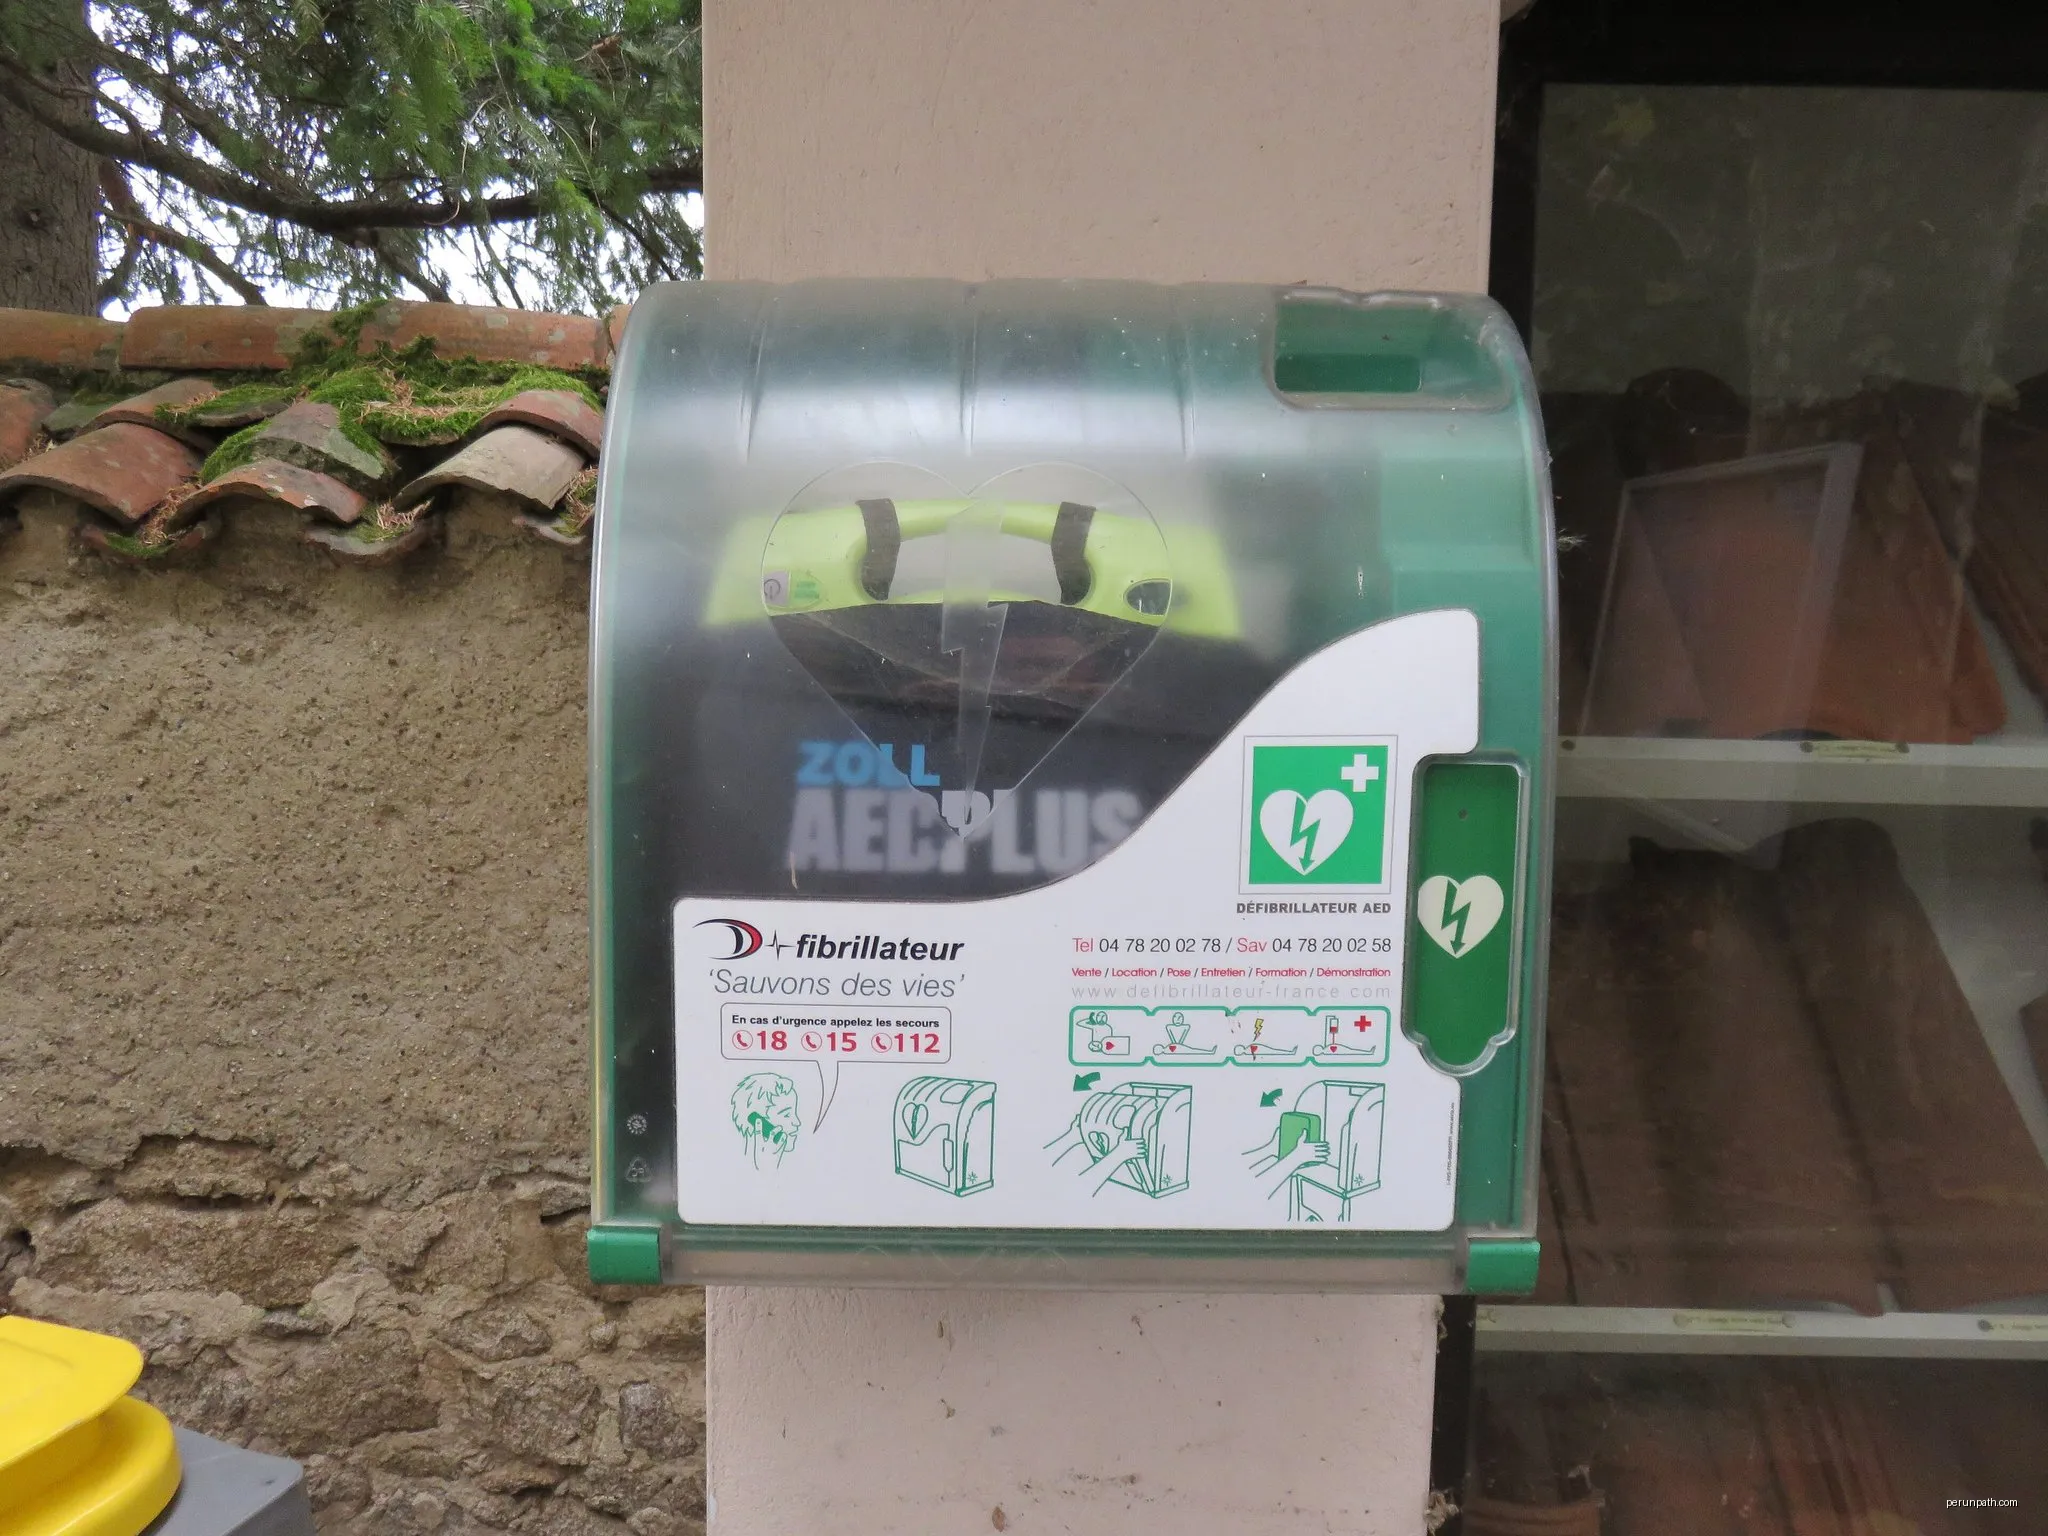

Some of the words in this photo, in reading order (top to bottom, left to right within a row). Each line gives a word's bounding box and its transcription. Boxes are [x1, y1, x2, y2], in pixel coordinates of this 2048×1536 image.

[796, 740, 941, 787] ZOLL
[1237, 900, 1357, 914] DÉFIBRILLATEUR
[1363, 902, 1393, 914] AED
[1072, 937, 1094, 953] Tel
[1099, 937, 1119, 953] 04
[1125, 937, 1144, 953] 78
[1150, 937, 1170, 953] 20
[1176, 937, 1196, 953] 02
[1202, 937, 1221, 953] 78
[1225, 937, 1233, 953] /
[1237, 937, 1267, 953] Sav
[1272, 937, 1292, 953] 04
[1298, 937, 1318, 953] 78
[1322, 937, 1342, 953] 20
[1347, 937, 1367, 953] 02
[1372, 937, 1392, 953] 58
[1072, 967, 1102, 979] Vente
[1112, 967, 1157, 979] Location
[1167, 967, 1191, 979] Pose
[1201, 967, 1245, 979] Entretien
[1255, 967, 1307, 979] Formation
[1317, 967, 1392, 979] Démonstration
[841, 972, 891, 996] des
[1072, 983, 1393, 999] wwwdefibrillateur-francecom
[731, 1014, 747, 1025] En
[750, 1017, 768, 1026] cas
[772, 1015, 827, 1028] d'urgence
[830, 1016, 872, 1029] appelez
[876, 1016, 892, 1027] les
[896, 1019, 940, 1028] secours
[757, 1030, 787, 1051] 18
[827, 1031, 857, 1052] 15
[895, 1032, 940, 1054] 112
